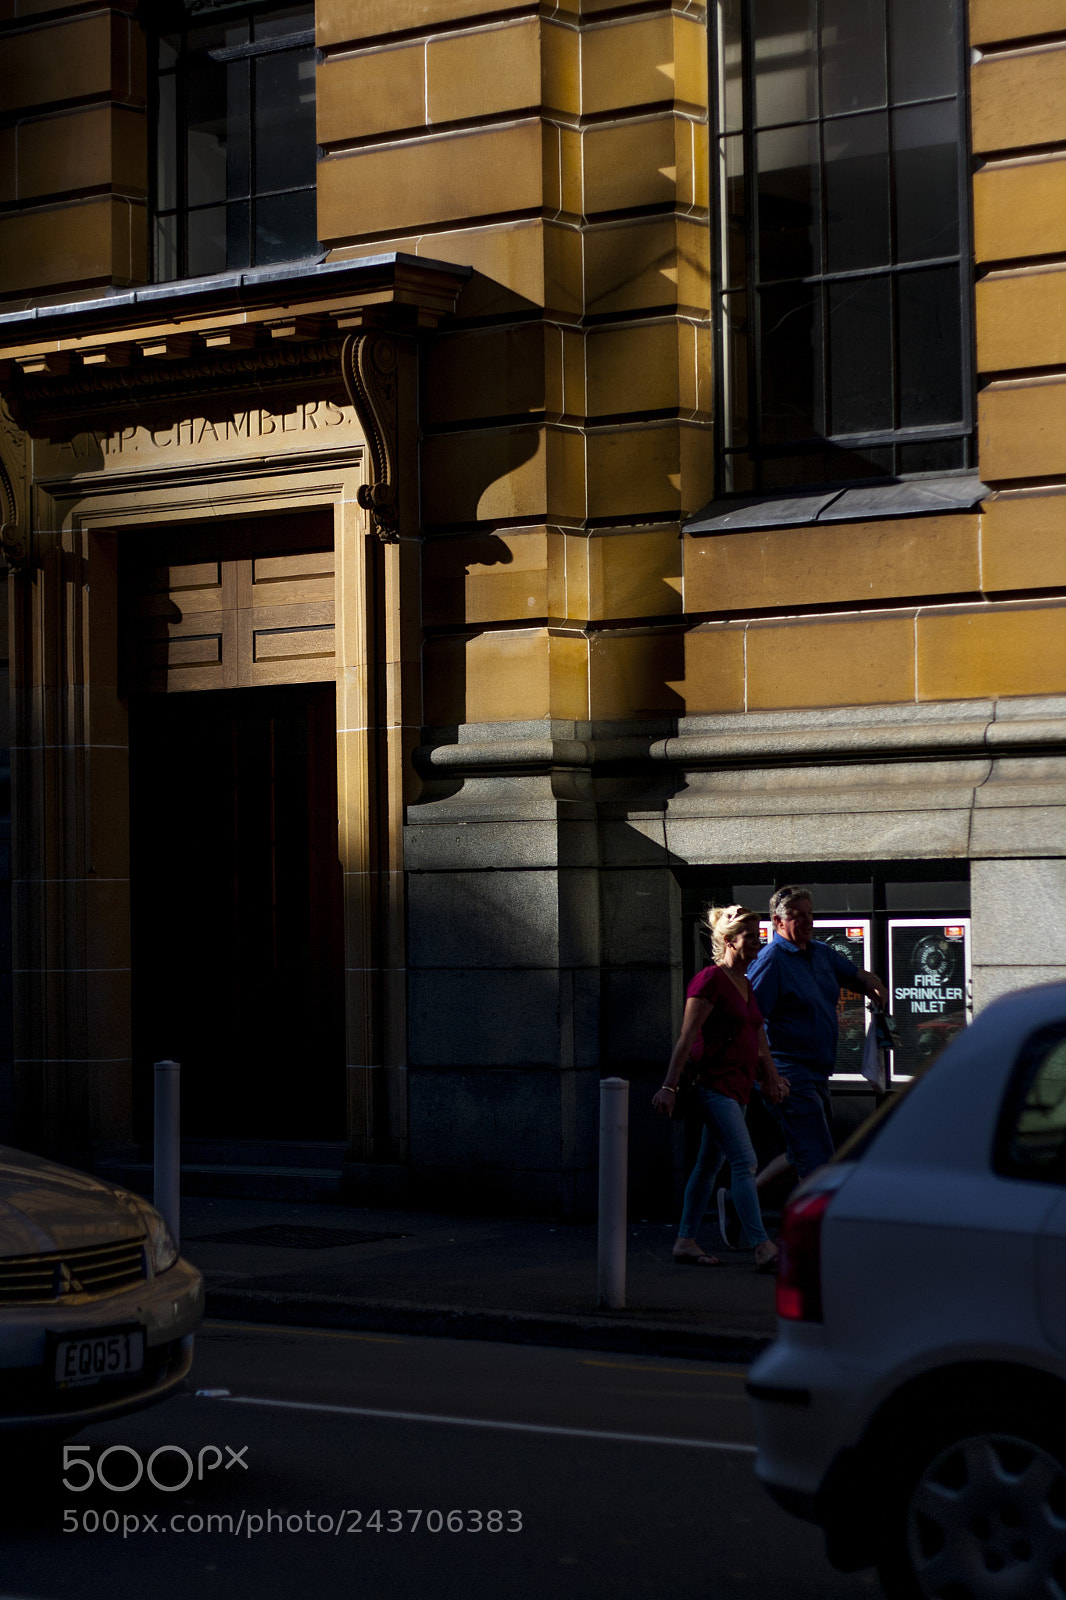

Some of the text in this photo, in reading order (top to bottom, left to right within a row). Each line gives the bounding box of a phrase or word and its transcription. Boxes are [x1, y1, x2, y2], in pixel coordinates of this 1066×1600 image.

[914, 974, 941, 987] FIRE
[894, 987, 963, 1000] SPRINKLER
[910, 1001, 946, 1013] INLET
